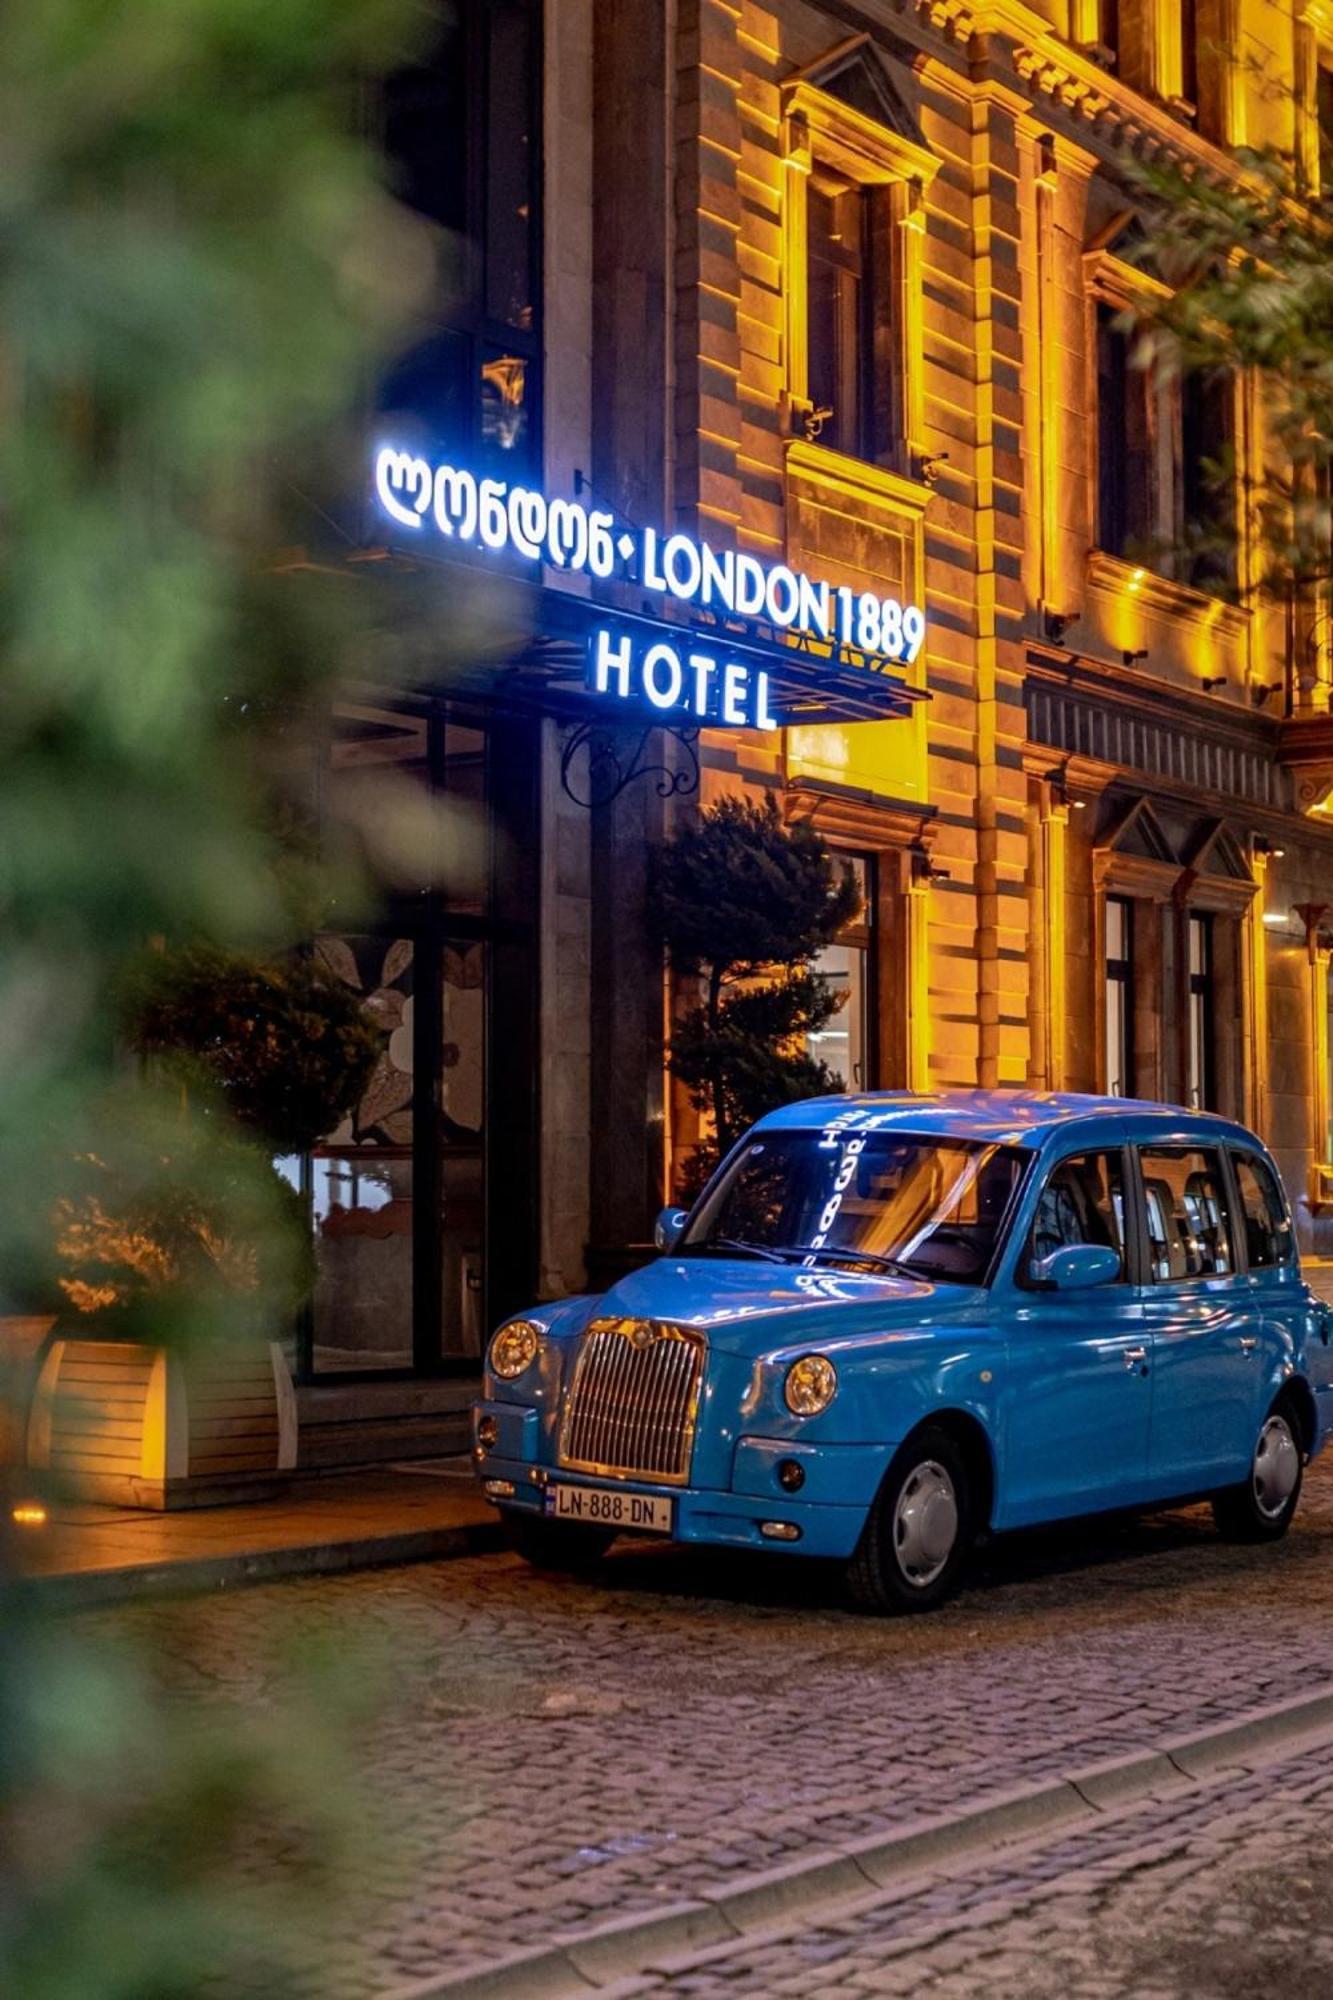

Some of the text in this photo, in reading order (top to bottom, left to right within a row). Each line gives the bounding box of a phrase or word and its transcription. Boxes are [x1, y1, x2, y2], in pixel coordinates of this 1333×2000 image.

[376, 449, 614, 578] ლონდონ
[644, 527, 925, 663] LONDON 1889
[596, 630, 777, 731] HOTEL
[559, 1489, 655, 1524] LN-888-DN
